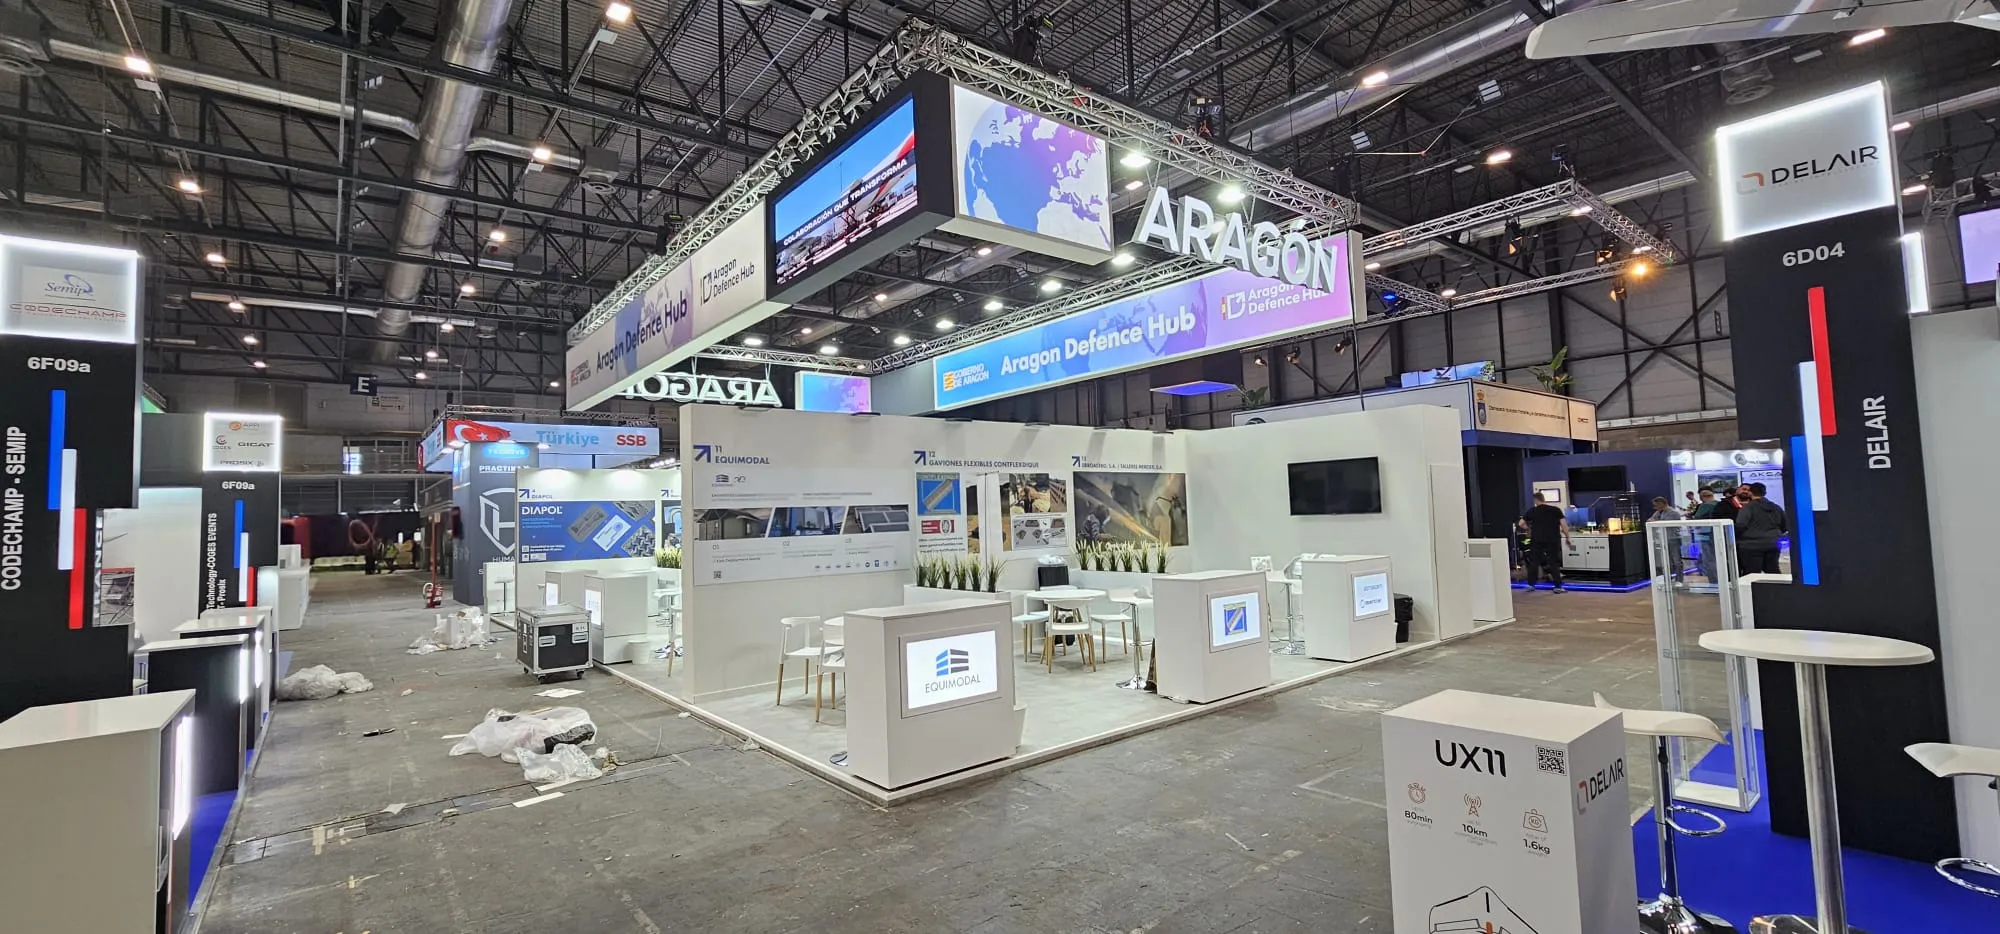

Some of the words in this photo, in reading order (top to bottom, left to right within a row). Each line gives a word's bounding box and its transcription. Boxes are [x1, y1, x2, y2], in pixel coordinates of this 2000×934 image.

[1771, 145, 1879, 185] DELAIR
[783, 208, 833, 246] COLABORACIÓN
[833, 197, 850, 213] QUE
[850, 158, 908, 201] TRANSFORMA
[1133, 185, 1338, 293] ARAGÓN
[1782, 242, 1845, 267] 6D04
[713, 258, 737, 280] Aragon
[713, 274, 740, 298] Defence
[741, 262, 755, 281] Hub
[9, 303, 127, 319] CODECHAMP
[1249, 293, 1300, 315] Defence
[596, 341, 624, 376] Aragon
[625, 315, 663, 352] Defence
[664, 290, 688, 329] Hub
[1001, 348, 1061, 376] Aragon
[1064, 325, 1144, 360] Defence
[1149, 305, 1196, 339] Hub
[27, 356, 91, 373] 6F09a
[357, 376, 370, 393] E
[536, 430, 599, 447] Türkiye
[616, 434, 647, 447] SSB
[1863, 395, 1892, 469] DELAIR
[5, 426, 27, 475] SEMIP
[715, 445, 722, 453] 11
[715, 456, 770, 465] EQUIMODAL
[929, 459, 962, 467] GAVIONES
[963, 460, 992, 468] FLEXIBLES
[222, 481, 256, 490] 6F09a
[521, 506, 563, 515] DIAPOL
[207, 513, 218, 542] EVENTS
[0, 487, 24, 591] CODECHAMP
[217, 579, 227, 601] Prosix
[925, 674, 981, 694] EQUIMODAL
[1435, 739, 1507, 777] UX11
[1590, 758, 1625, 801] DELAIR
[1404, 810, 1433, 824] 80min
[1462, 823, 1488, 838] 10km
[1523, 838, 1550, 855] 1.6kg
